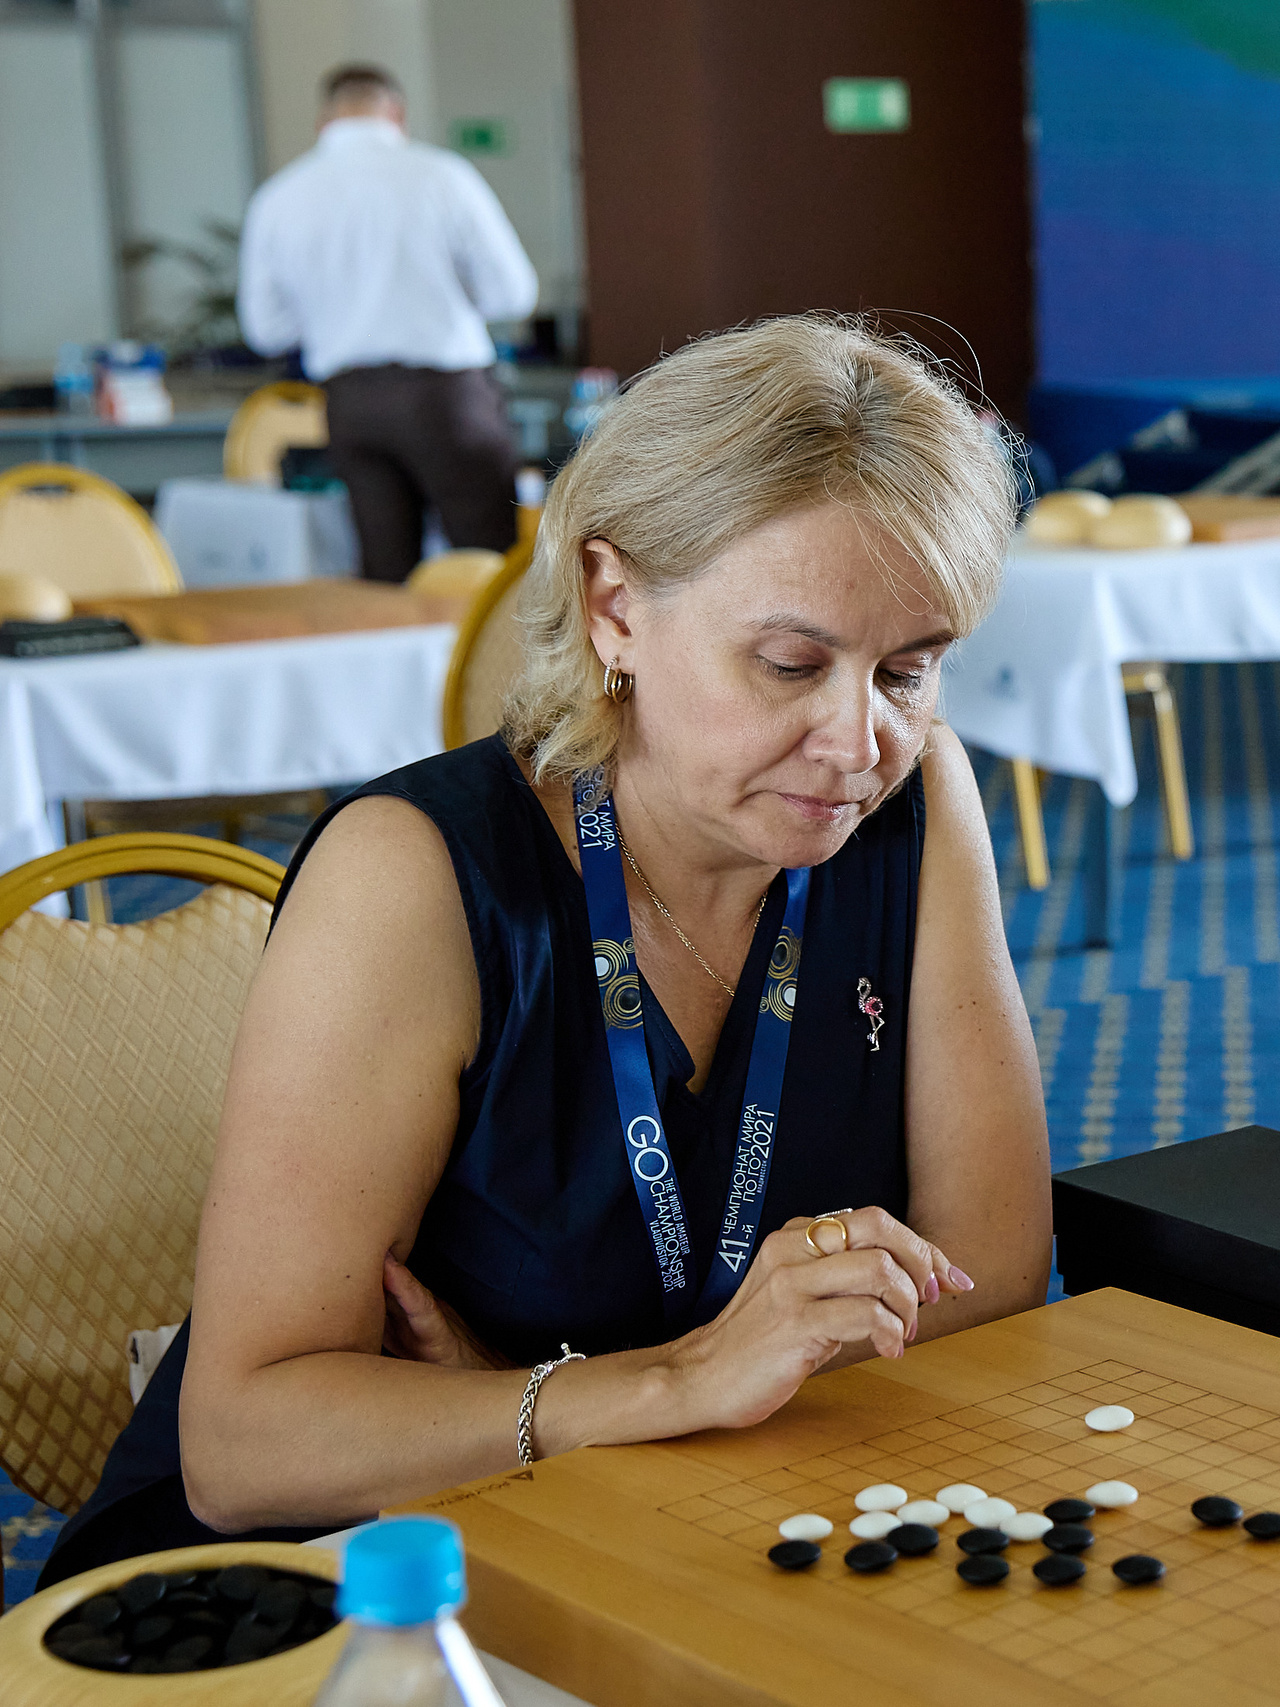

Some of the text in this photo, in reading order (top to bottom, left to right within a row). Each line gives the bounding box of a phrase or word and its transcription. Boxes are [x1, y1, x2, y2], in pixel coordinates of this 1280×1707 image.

[577, 803, 603, 848] 2021
[598, 811, 616, 851] МИРА
[627, 1115, 669, 1182] GO
[723, 1103, 758, 1234] ЧЕМПИОНАТ МИРА
[743, 1110, 774, 1202] ПО ГО 2021
[650, 1181, 686, 1289] CHAMPIONSHIP
[664, 1177, 690, 1255] THE WORLD AMATEUR
[649, 1220, 674, 1292] VLADIVOSTOK 2021
